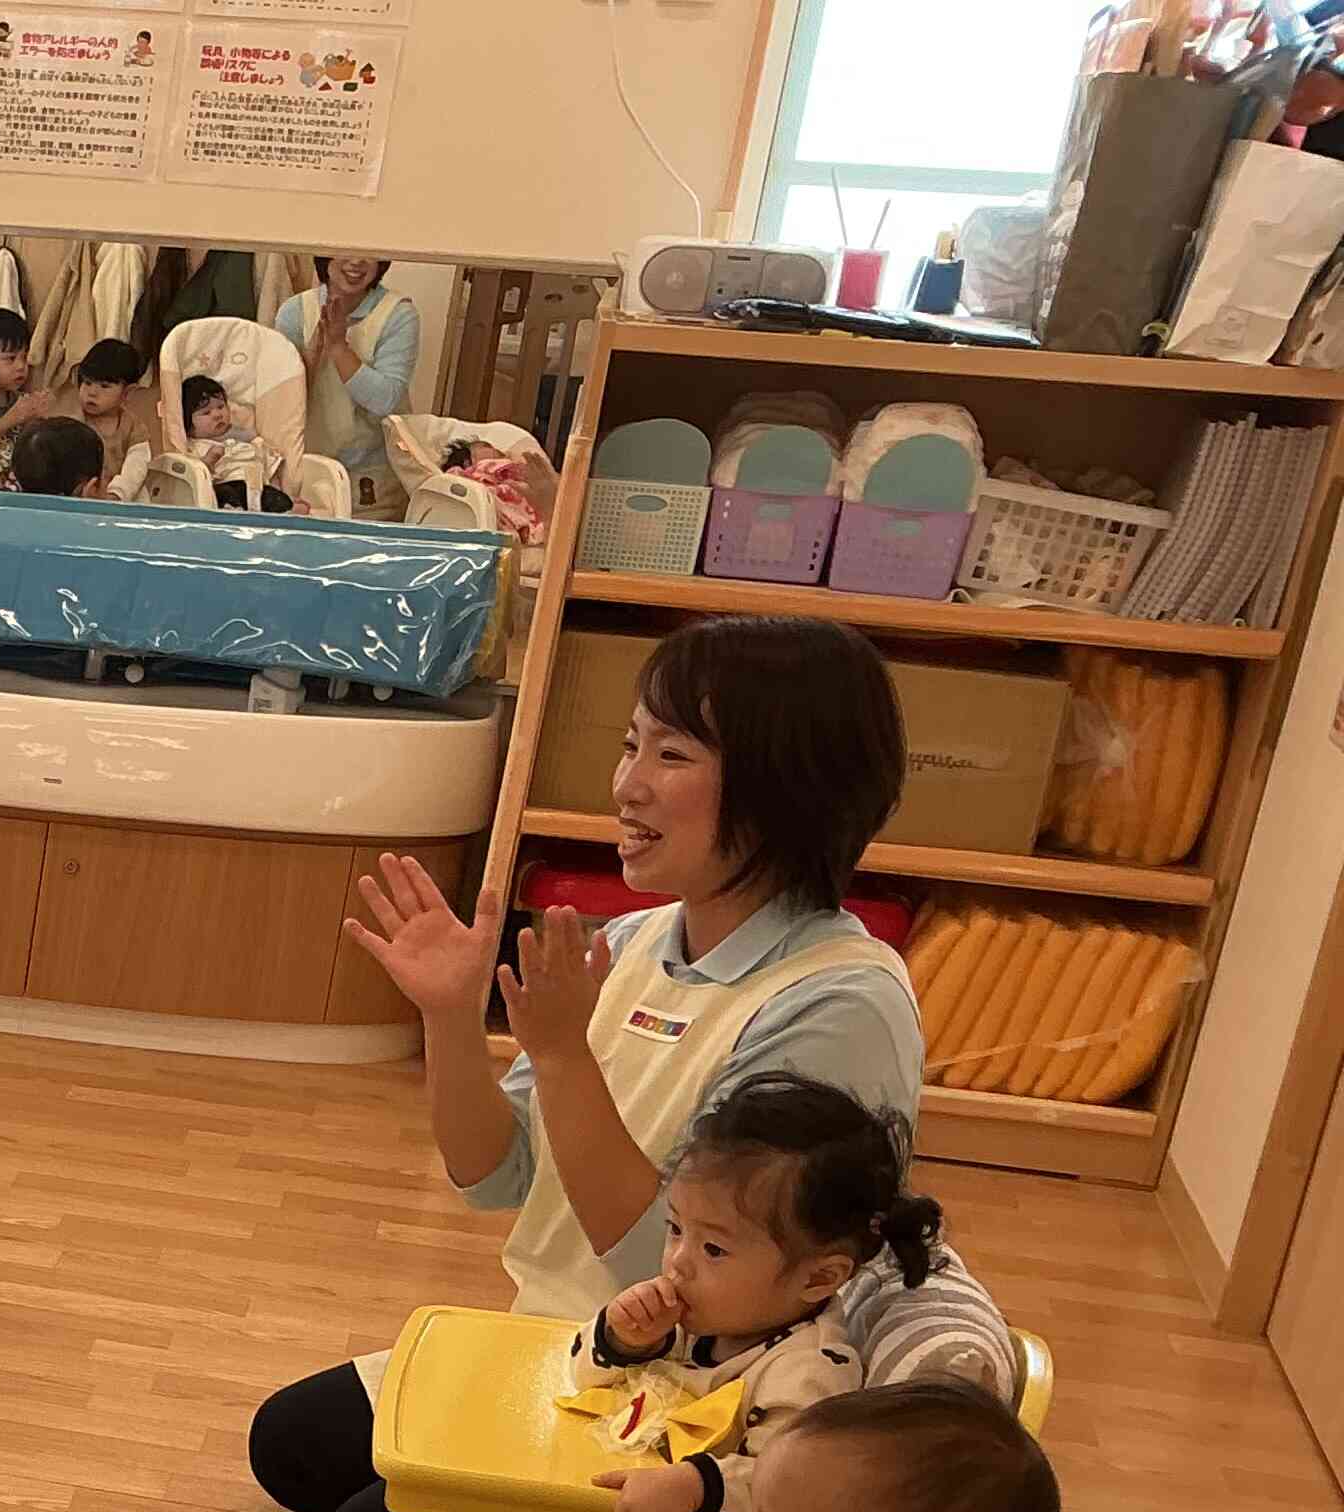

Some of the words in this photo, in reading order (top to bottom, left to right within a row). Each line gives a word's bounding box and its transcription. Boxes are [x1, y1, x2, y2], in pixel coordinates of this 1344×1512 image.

[18, 45, 112, 61] エラーを防ぎましょう
[219, 70, 285, 85] 注意しましょう
